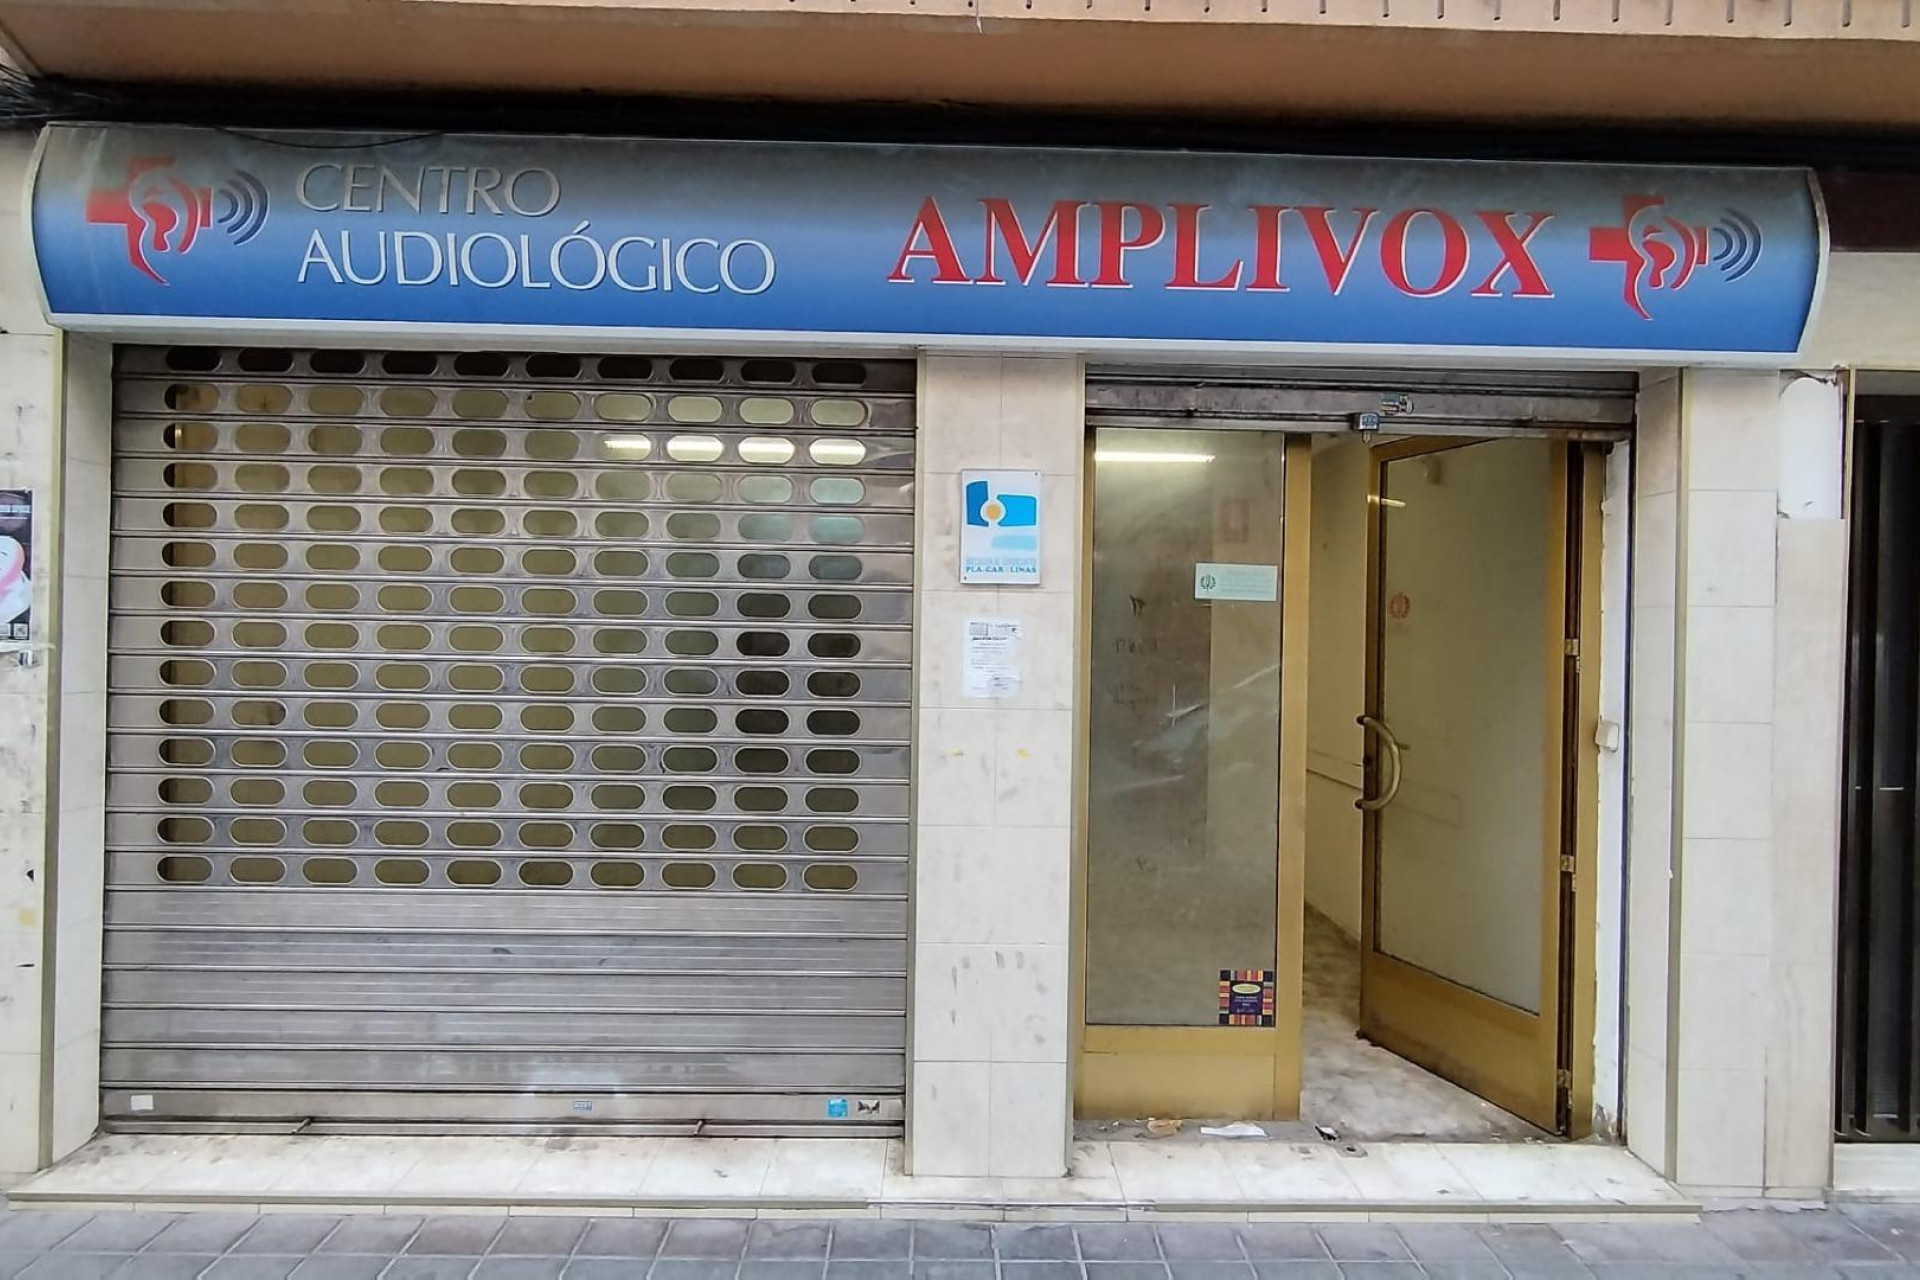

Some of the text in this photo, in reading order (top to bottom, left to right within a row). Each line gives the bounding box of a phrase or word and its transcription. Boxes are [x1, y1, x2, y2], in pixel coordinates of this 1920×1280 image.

[297, 163, 562, 217] CENTRO
[297, 219, 777, 295] AUDIOLÓGICO
[887, 196, 1554, 298] AMPLIVOX
